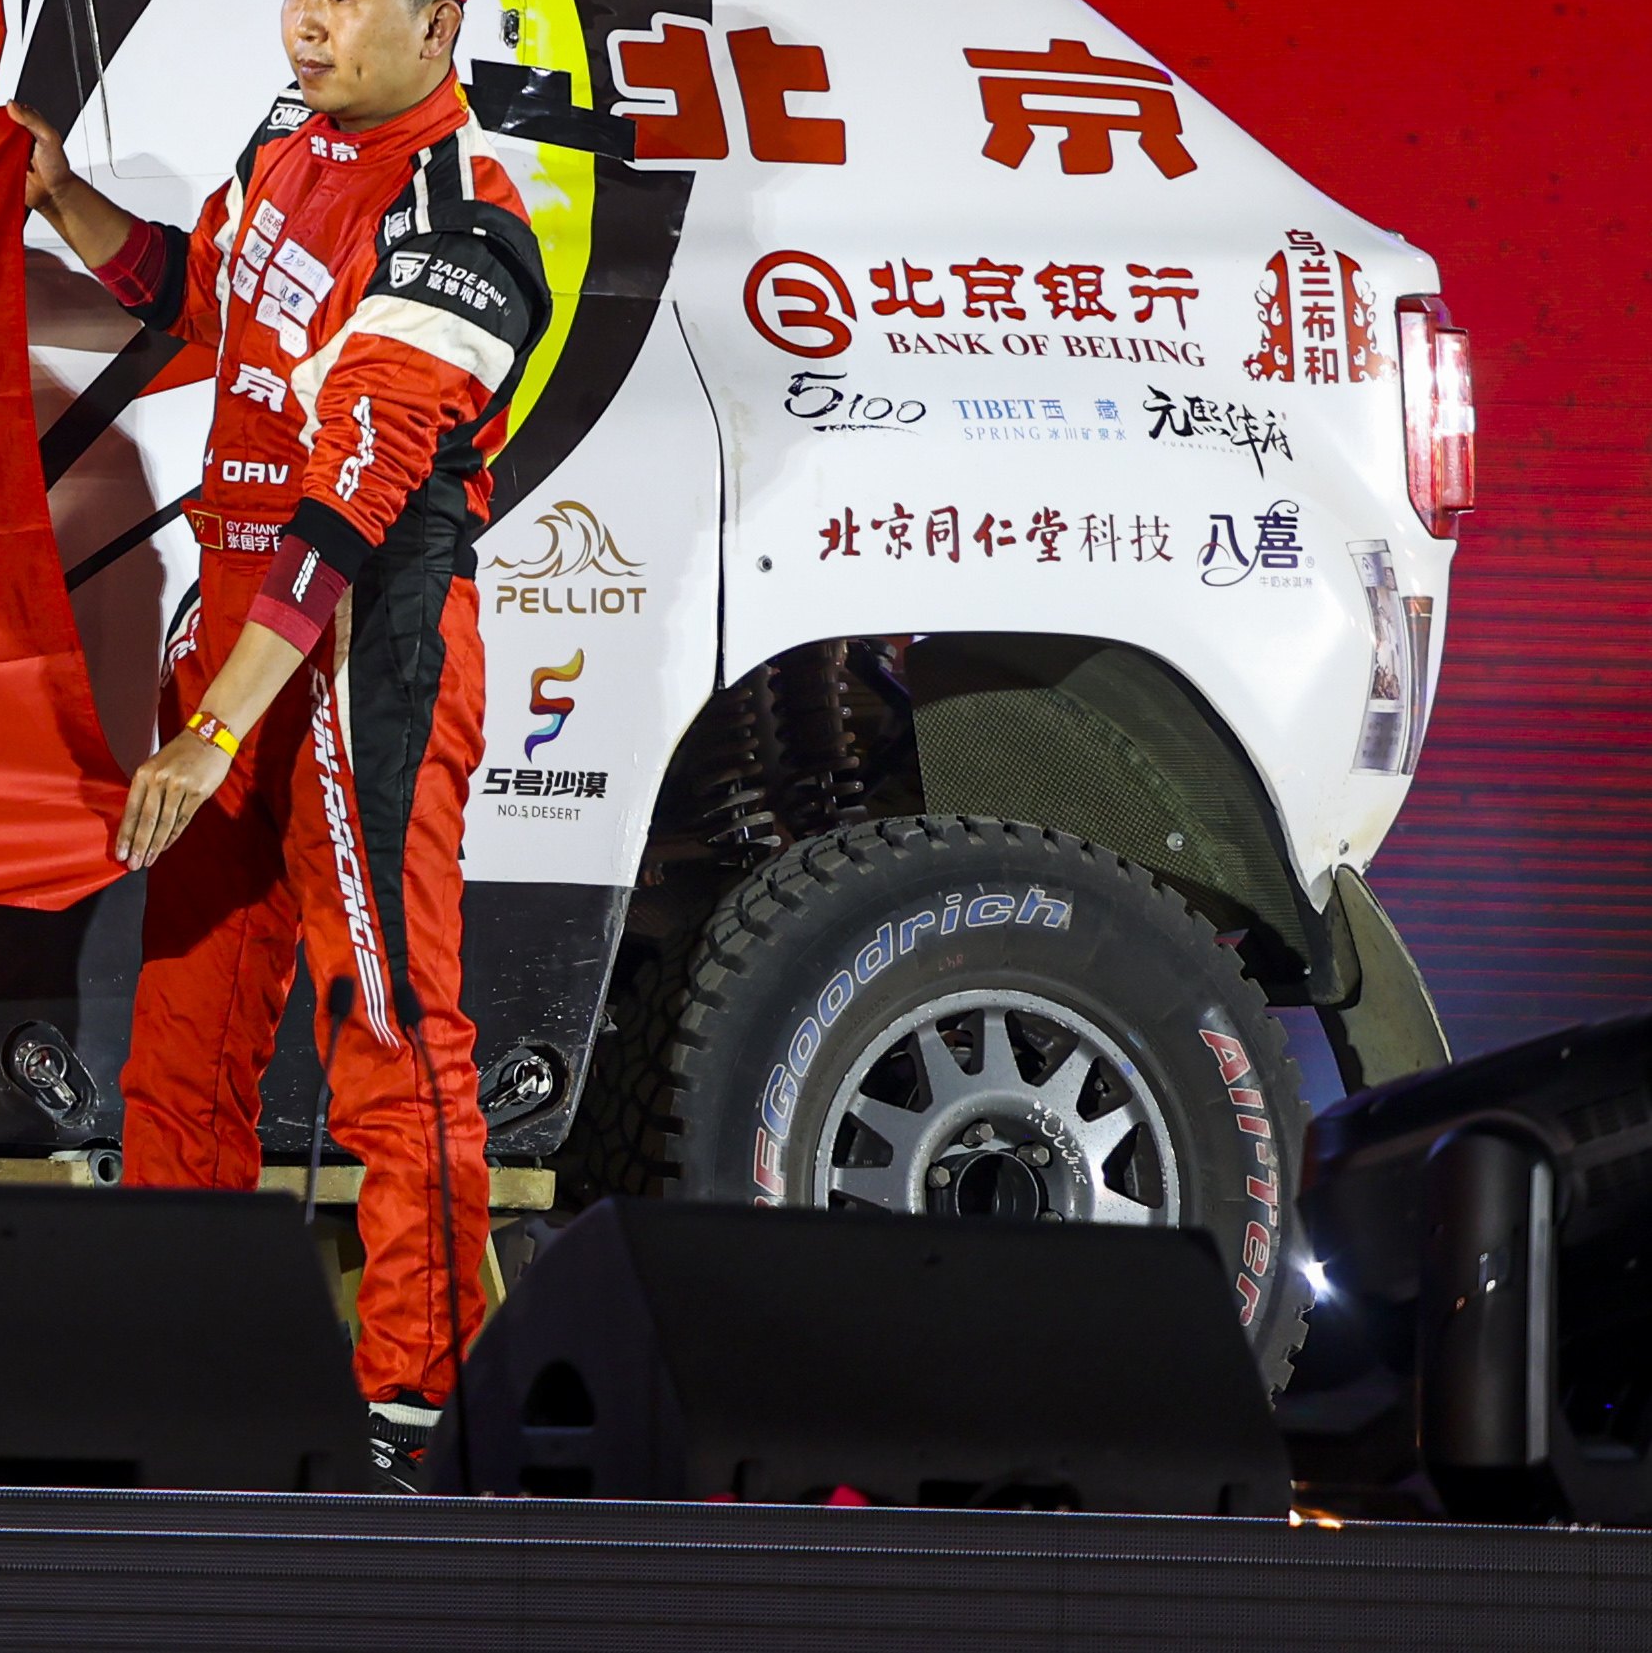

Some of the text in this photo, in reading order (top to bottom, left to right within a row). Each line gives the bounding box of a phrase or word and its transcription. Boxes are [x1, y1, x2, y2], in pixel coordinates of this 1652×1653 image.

[270, 106, 310, 127] OMP
[617, 22, 1199, 181] 北京
[309, 134, 360, 162] 北京
[868, 256, 1200, 331] 北京银行
[1284, 228, 1340, 385] 乌兰布和
[885, 331, 1207, 368] BANK OF BEIJING
[951, 398, 1123, 425] TIBET 西藏
[963, 426, 1042, 442] SPRING
[818, 502, 1176, 566] 北京同仁堂科技
[1199, 504, 1303, 580] 八喜
[496, 585, 647, 614] PELLIOT
[480, 768, 609, 799] 5号沙漠
[532, 805, 582, 822] DESERT
[1198, 1028, 1279, 1327] All-Ter
